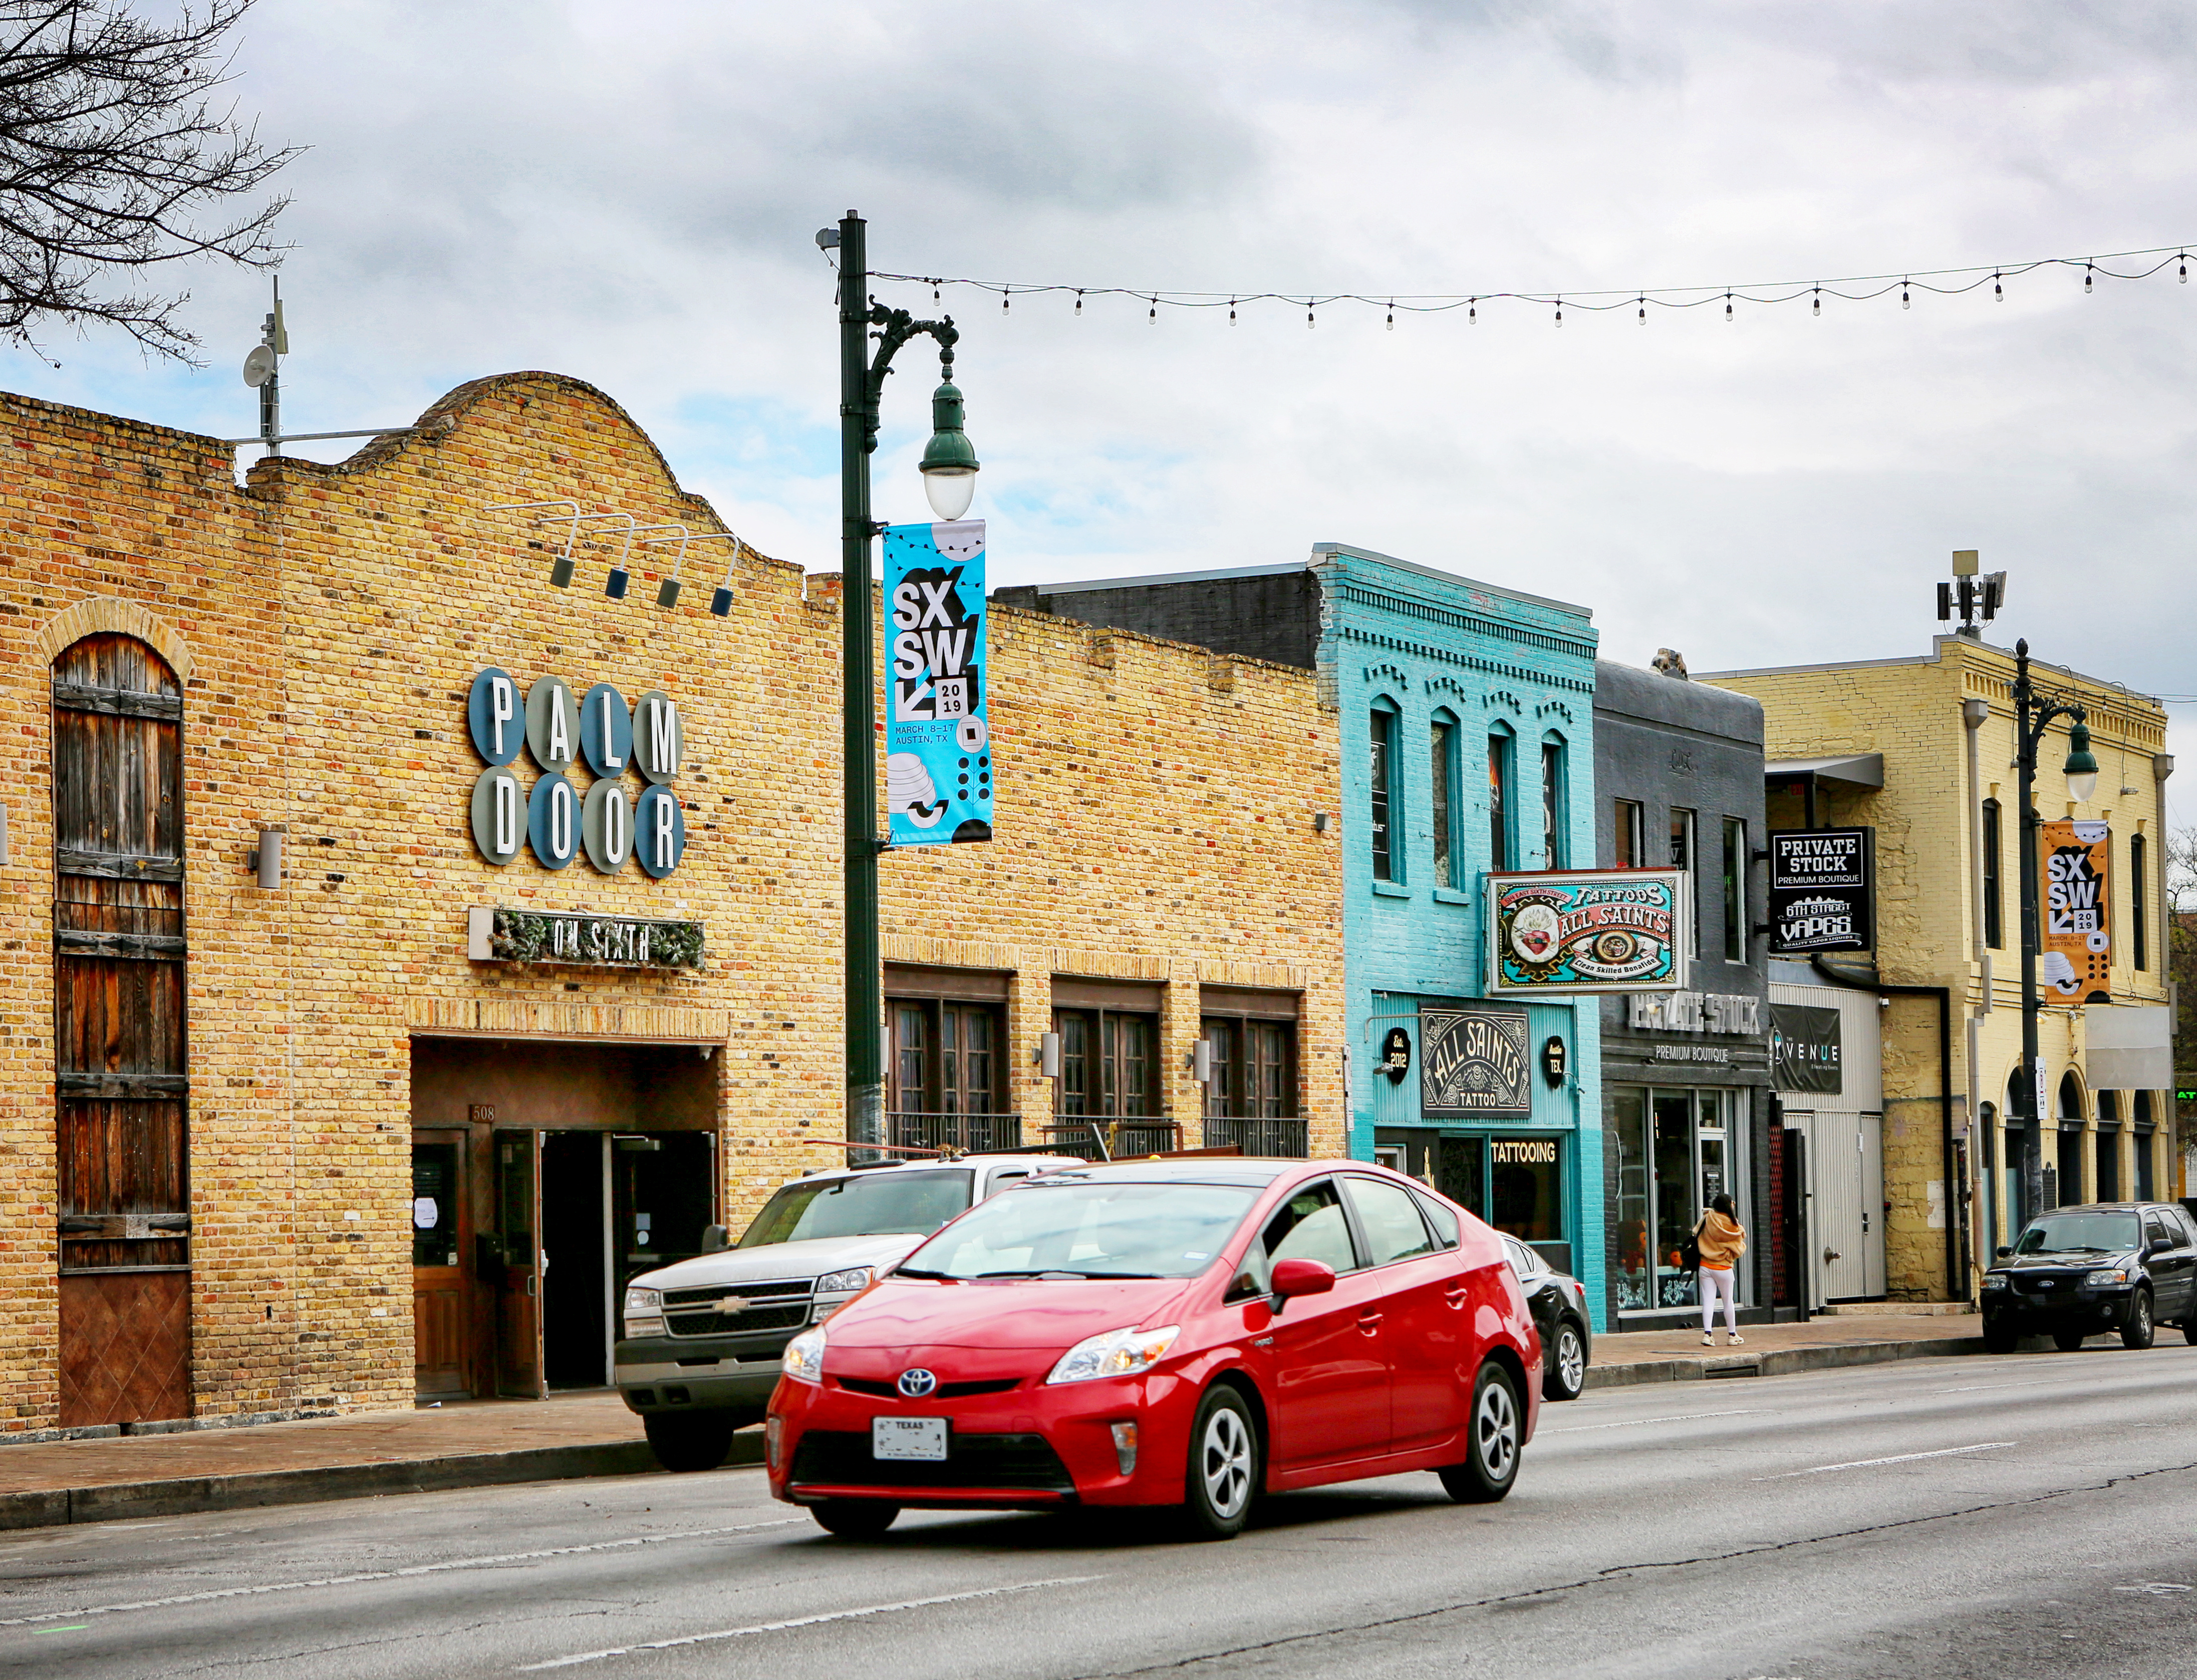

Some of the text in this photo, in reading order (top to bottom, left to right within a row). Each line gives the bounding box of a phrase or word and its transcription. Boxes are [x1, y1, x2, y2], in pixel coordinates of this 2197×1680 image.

[893, 581, 954, 631] SX
[894, 629, 967, 679] SW
[942, 684, 960, 697] 20
[944, 700, 961, 712] 19
[492, 676, 677, 775] PALM
[896, 726, 924, 734] MARCH
[896, 735, 933, 744] AUSTIN,
[496, 775, 674, 869] DOOR
[1781, 838, 1856, 856] PRIVATE
[1790, 856, 1847, 873] STOCK
[2047, 854, 2087, 882] SX
[1778, 875, 1859, 884] PREMIUM BOUTIQUE
[1504, 895, 1515, 904] 514
[1547, 890, 1568, 900] STREET
[1572, 886, 1666, 906] TATTOOS
[2048, 882, 2095, 910] SW
[1786, 903, 1851, 917] 6TH STREET
[1560, 906, 1667, 940] ALL SAINTS
[1781, 916, 1851, 941] VAPES
[554, 920, 649, 961] ON SIXTH
[1574, 960, 1595, 971] Clean
[1624, 958, 1657, 972] Bonafide
[1705, 993, 1761, 1035] STOCK
[1391, 1052, 1407, 1068] 2012
[1435, 1021, 1520, 1088] ALL SAINTS
[1656, 1045, 1728, 1062] PREMIUM BOUTIQUE
[1786, 1043, 1838, 1061] VENUE
[1550, 1059, 1562, 1073] TEX.
[1460, 1092, 1496, 1106] TATTOO
[2176, 1091, 2197, 1099] AT
[474, 1106, 494, 1121] 508
[1491, 1142, 1555, 1163] TATTOOING
[1376, 1158, 1384, 1166] 514
[896, 1421, 924, 1429] TEXAS
